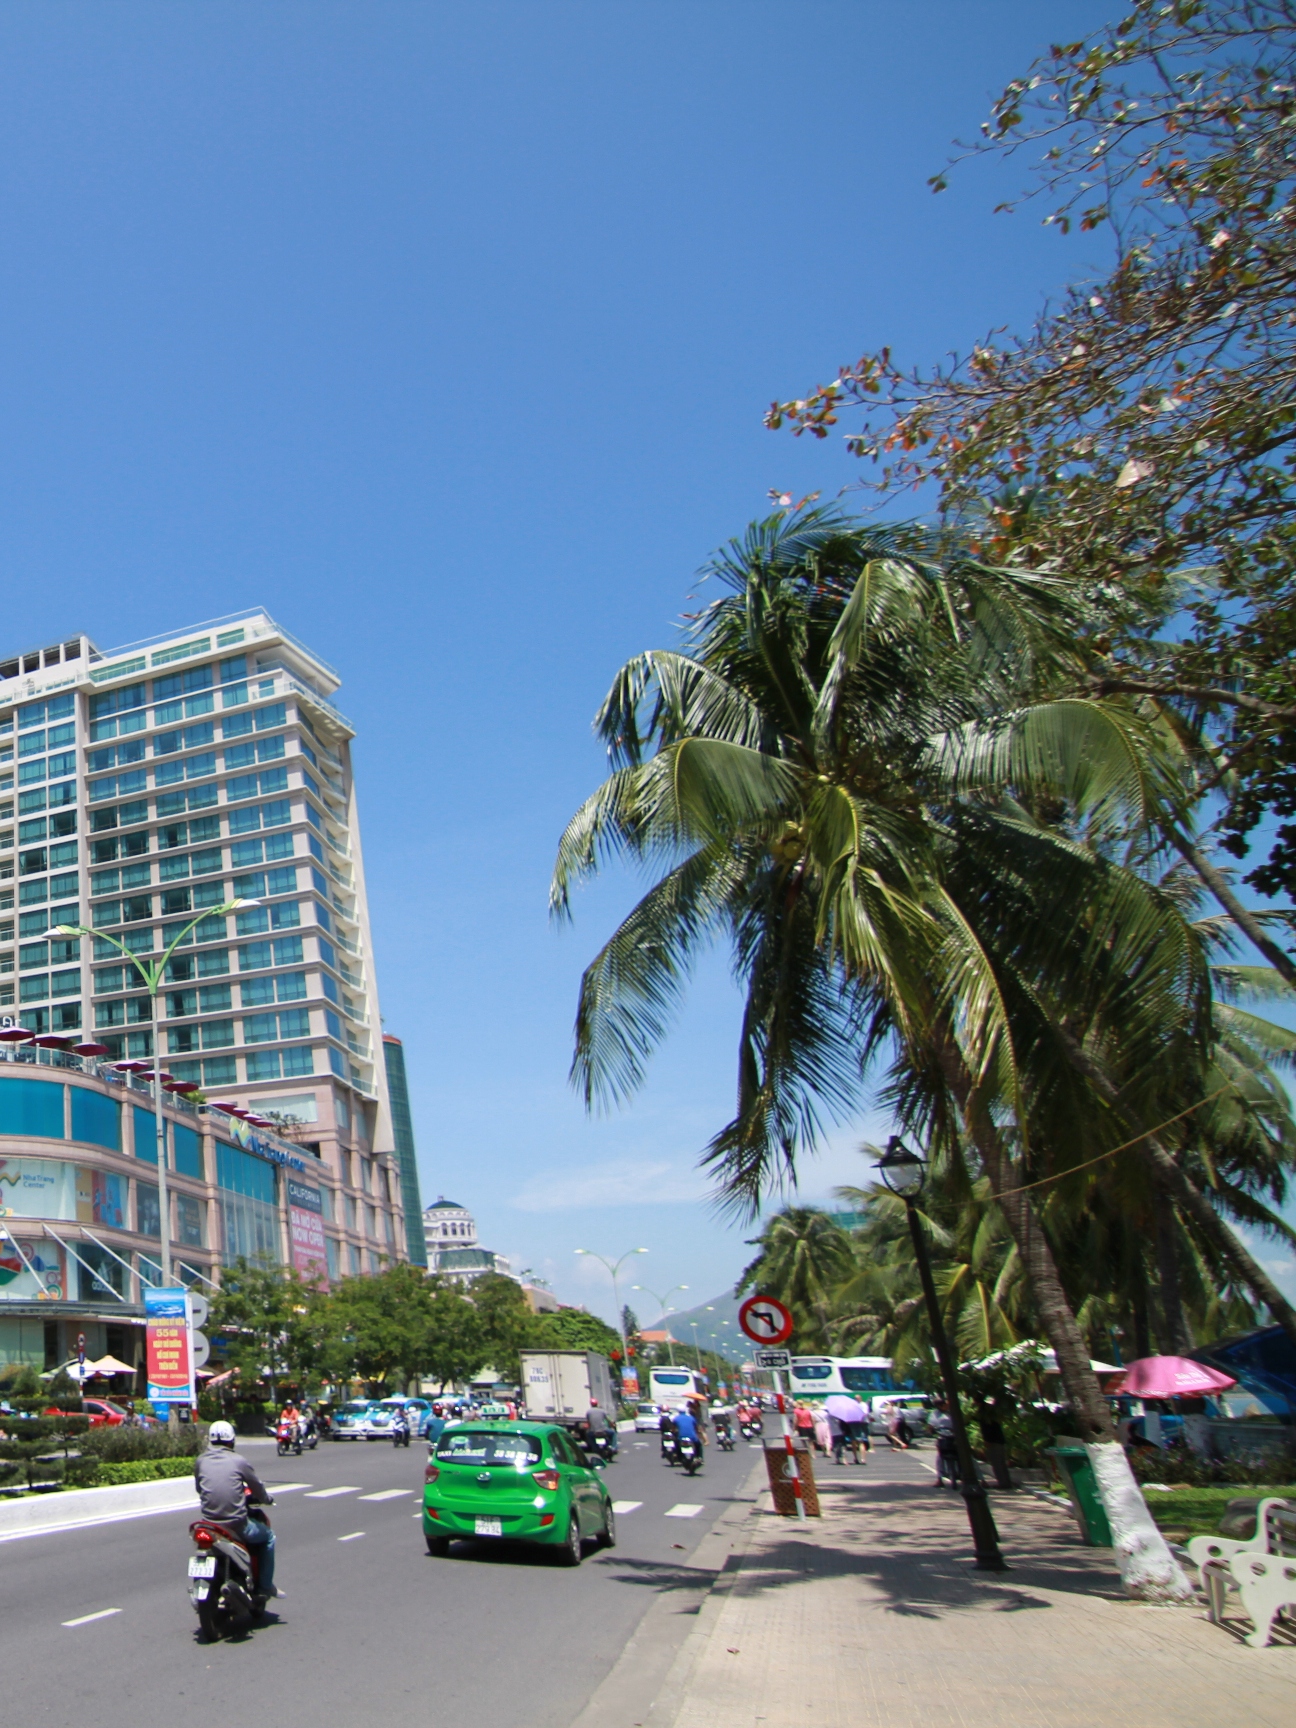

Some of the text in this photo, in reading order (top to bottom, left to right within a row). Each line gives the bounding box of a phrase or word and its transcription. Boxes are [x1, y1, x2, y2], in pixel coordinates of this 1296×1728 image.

[37, 1175, 54, 1184] Trang
[289, 1184, 320, 1203] CALIFORNIA
[292, 1227, 324, 1247] NOW OPEN
[156, 1329, 169, 1337] 55
